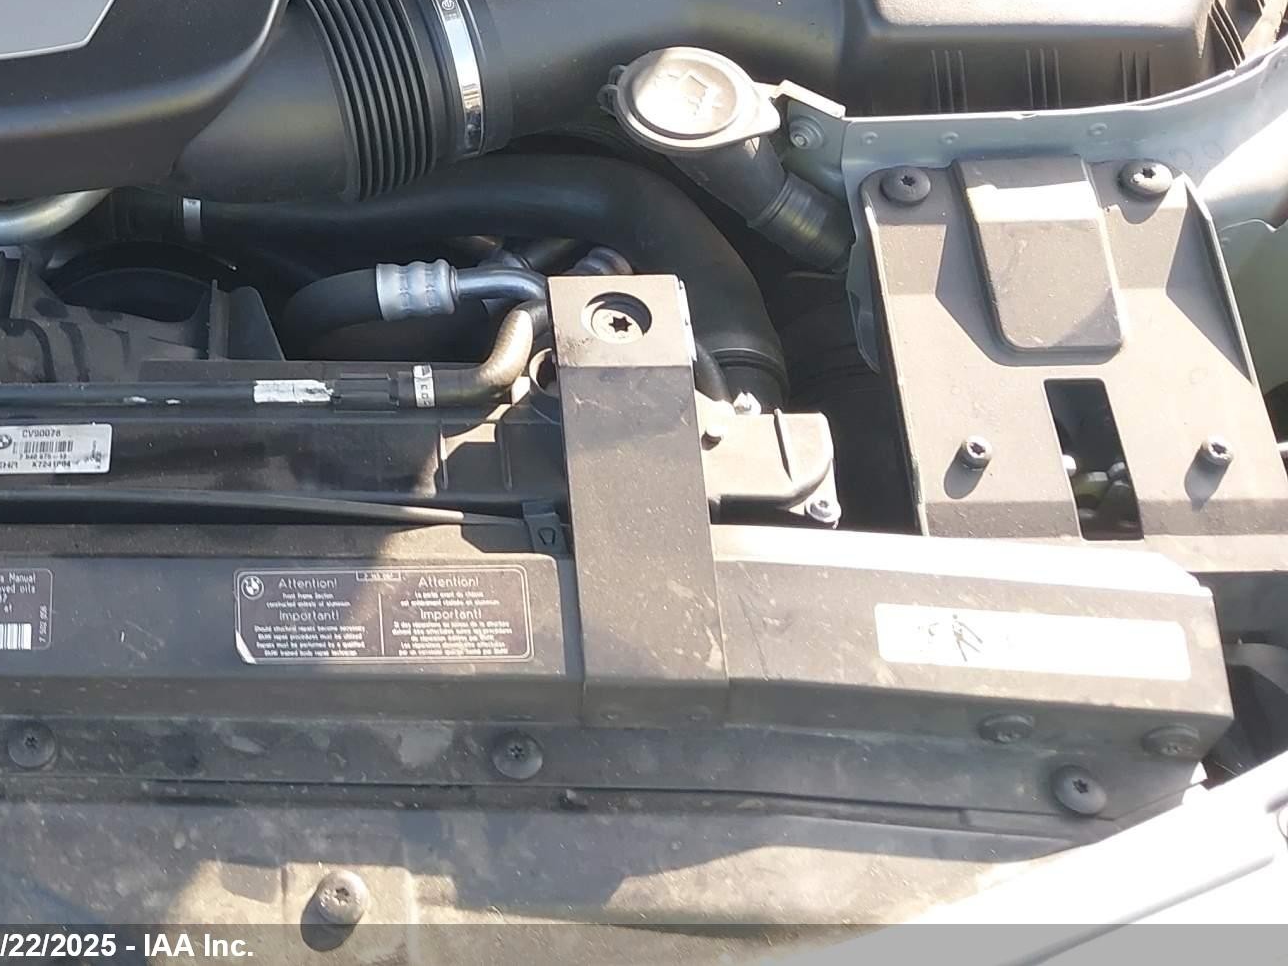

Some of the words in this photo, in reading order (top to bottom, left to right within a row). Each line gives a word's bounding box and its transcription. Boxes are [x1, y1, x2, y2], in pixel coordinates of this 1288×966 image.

[9, 572, 36, 583] Manual
[278, 577, 338, 589] Attention!
[418, 575, 479, 588] Attention!
[279, 609, 339, 622] Important!
[419, 608, 482, 621] Important!
